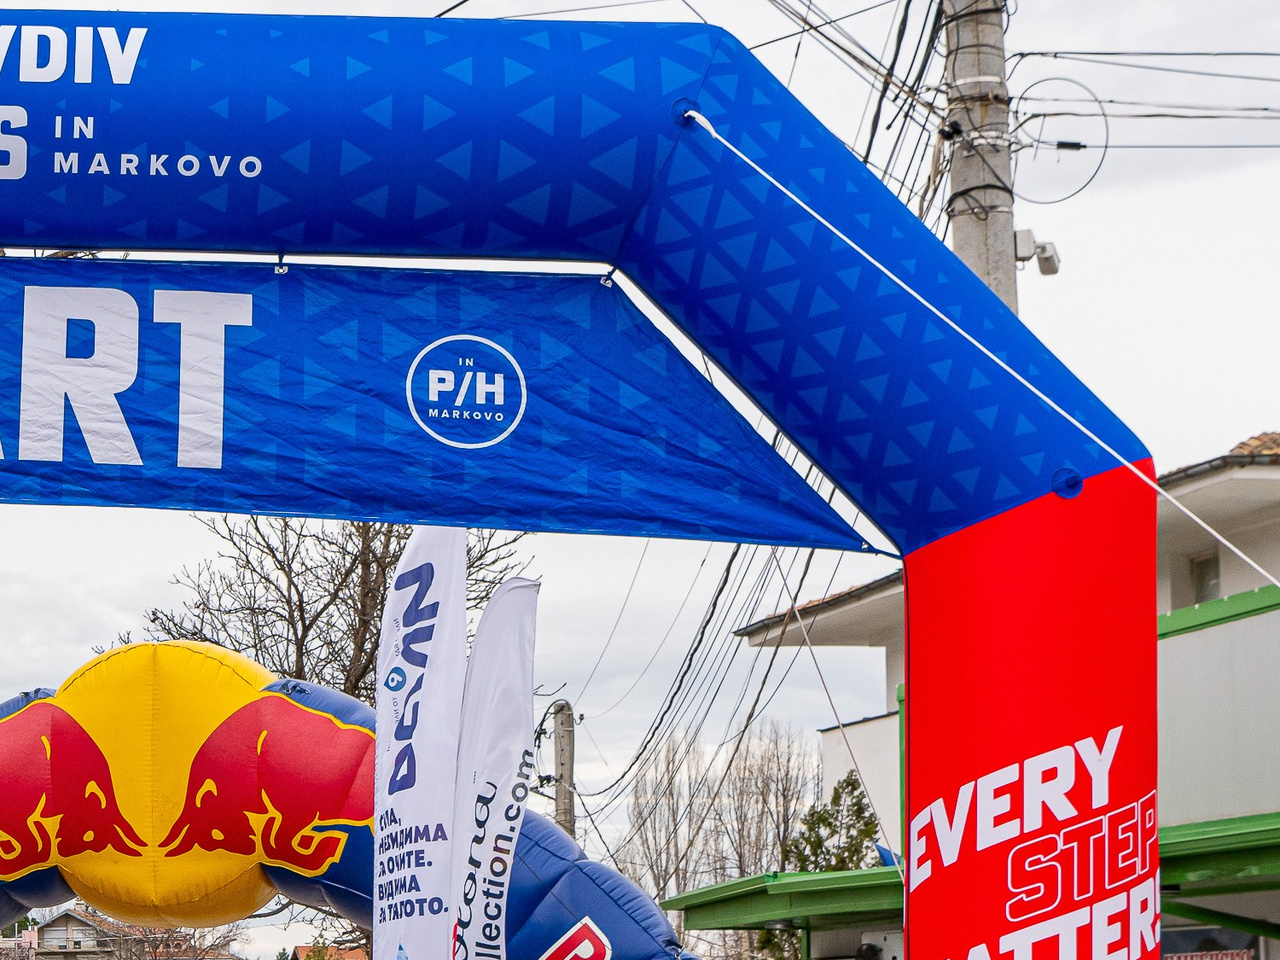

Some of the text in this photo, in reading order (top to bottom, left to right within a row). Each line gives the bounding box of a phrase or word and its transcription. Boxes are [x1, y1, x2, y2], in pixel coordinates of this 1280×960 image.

[53, 115, 95, 139] IN
[53, 151, 263, 178] MARKOVO
[458, 357, 474, 367] IN
[428, 369, 505, 407] P/H
[428, 408, 504, 422] MARKOVO
[909, 725, 1124, 893] EVERY
[1006, 789, 1158, 923] STEP
